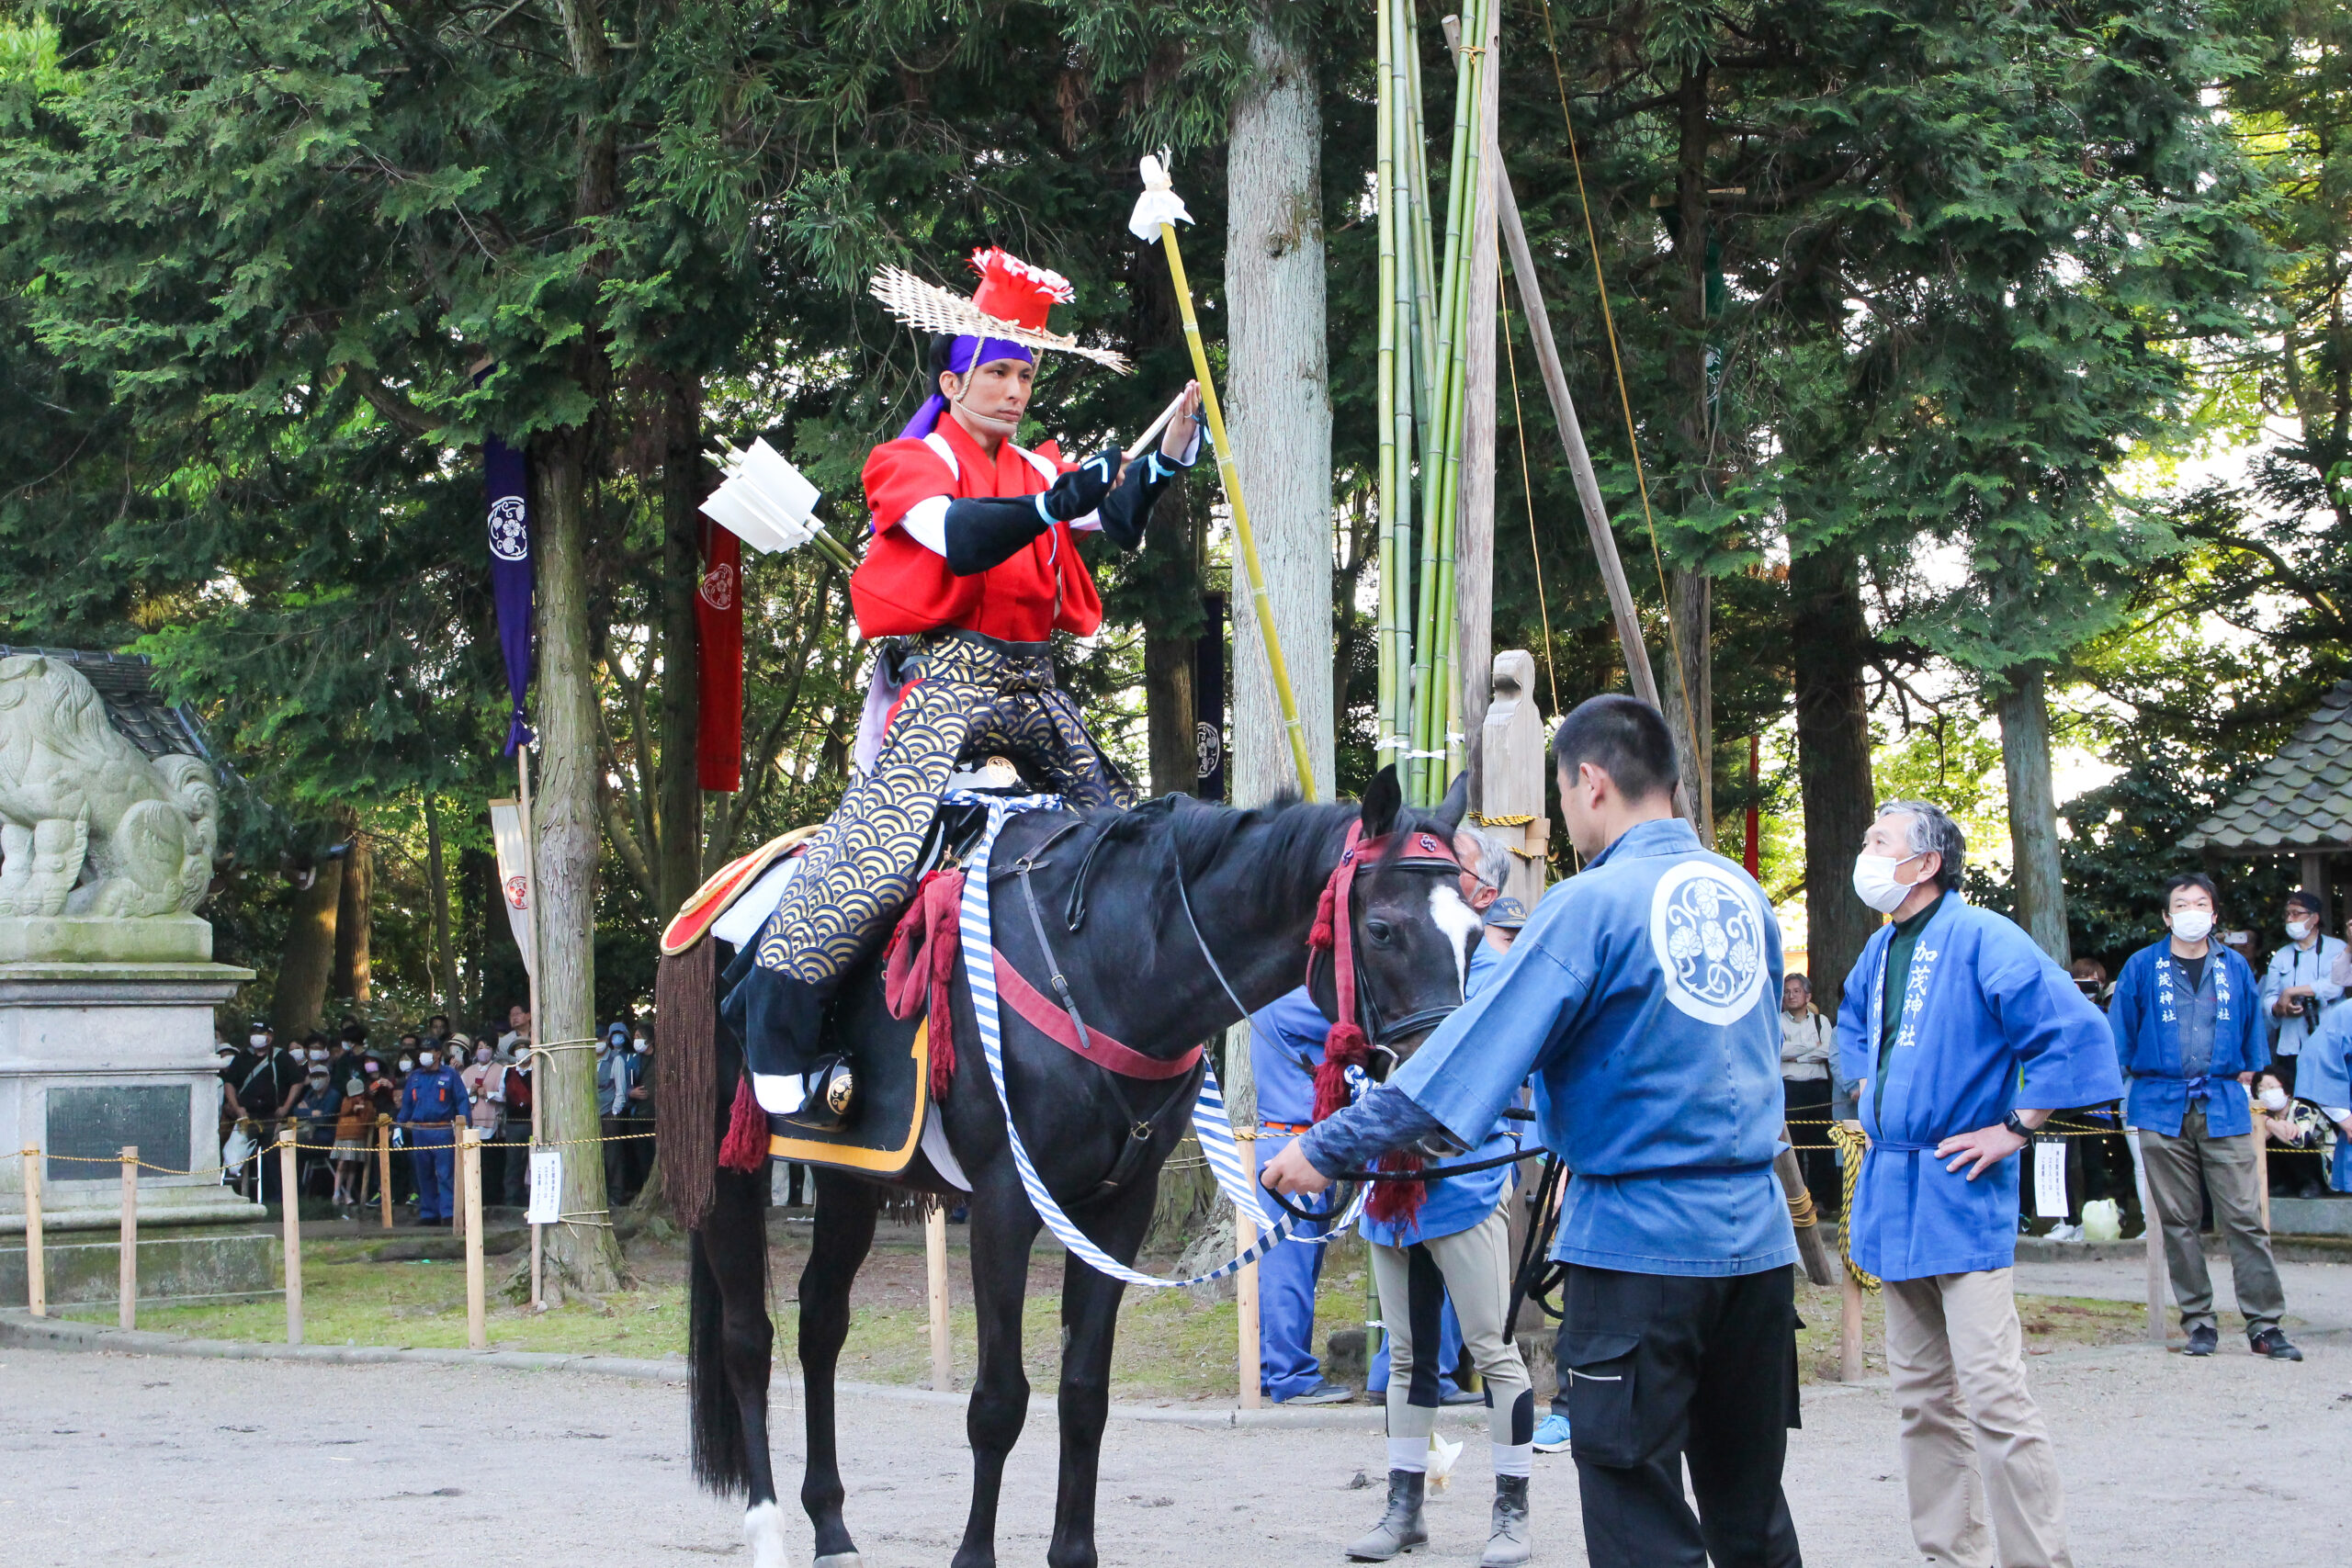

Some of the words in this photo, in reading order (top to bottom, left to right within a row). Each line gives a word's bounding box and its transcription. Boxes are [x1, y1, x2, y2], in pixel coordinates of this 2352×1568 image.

[1897, 941, 1938, 1047] 加茂神社
[2155, 957, 2177, 1022] 加茂神社
[2213, 957, 2231, 1021] 加茂神社
